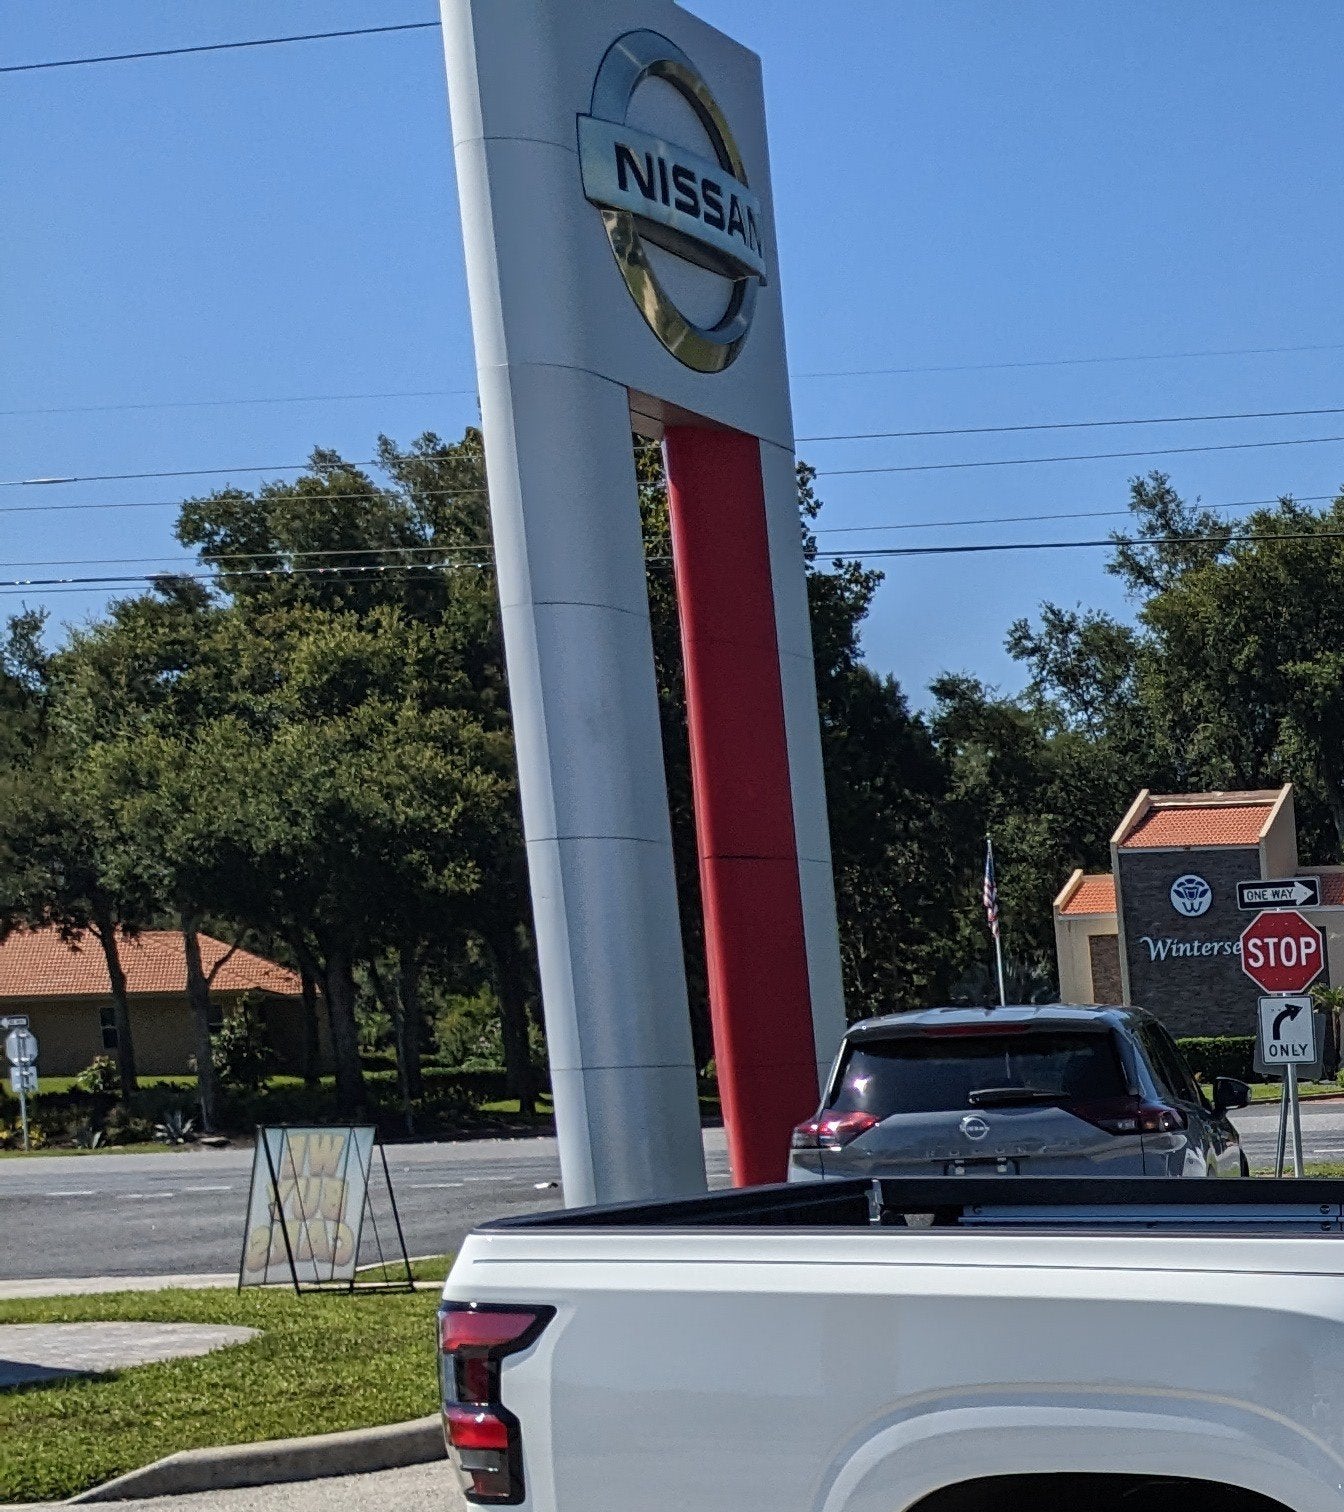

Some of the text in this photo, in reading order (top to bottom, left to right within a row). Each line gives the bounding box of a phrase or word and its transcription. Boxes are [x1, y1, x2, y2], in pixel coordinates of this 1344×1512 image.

[615, 142, 763, 258] NISSAN
[1246, 888, 1294, 901] ONE WAY
[1139, 936, 1242, 961] Winterse
[1247, 936, 1317, 968] STOP
[1269, 1043, 1308, 1057] ONLY
